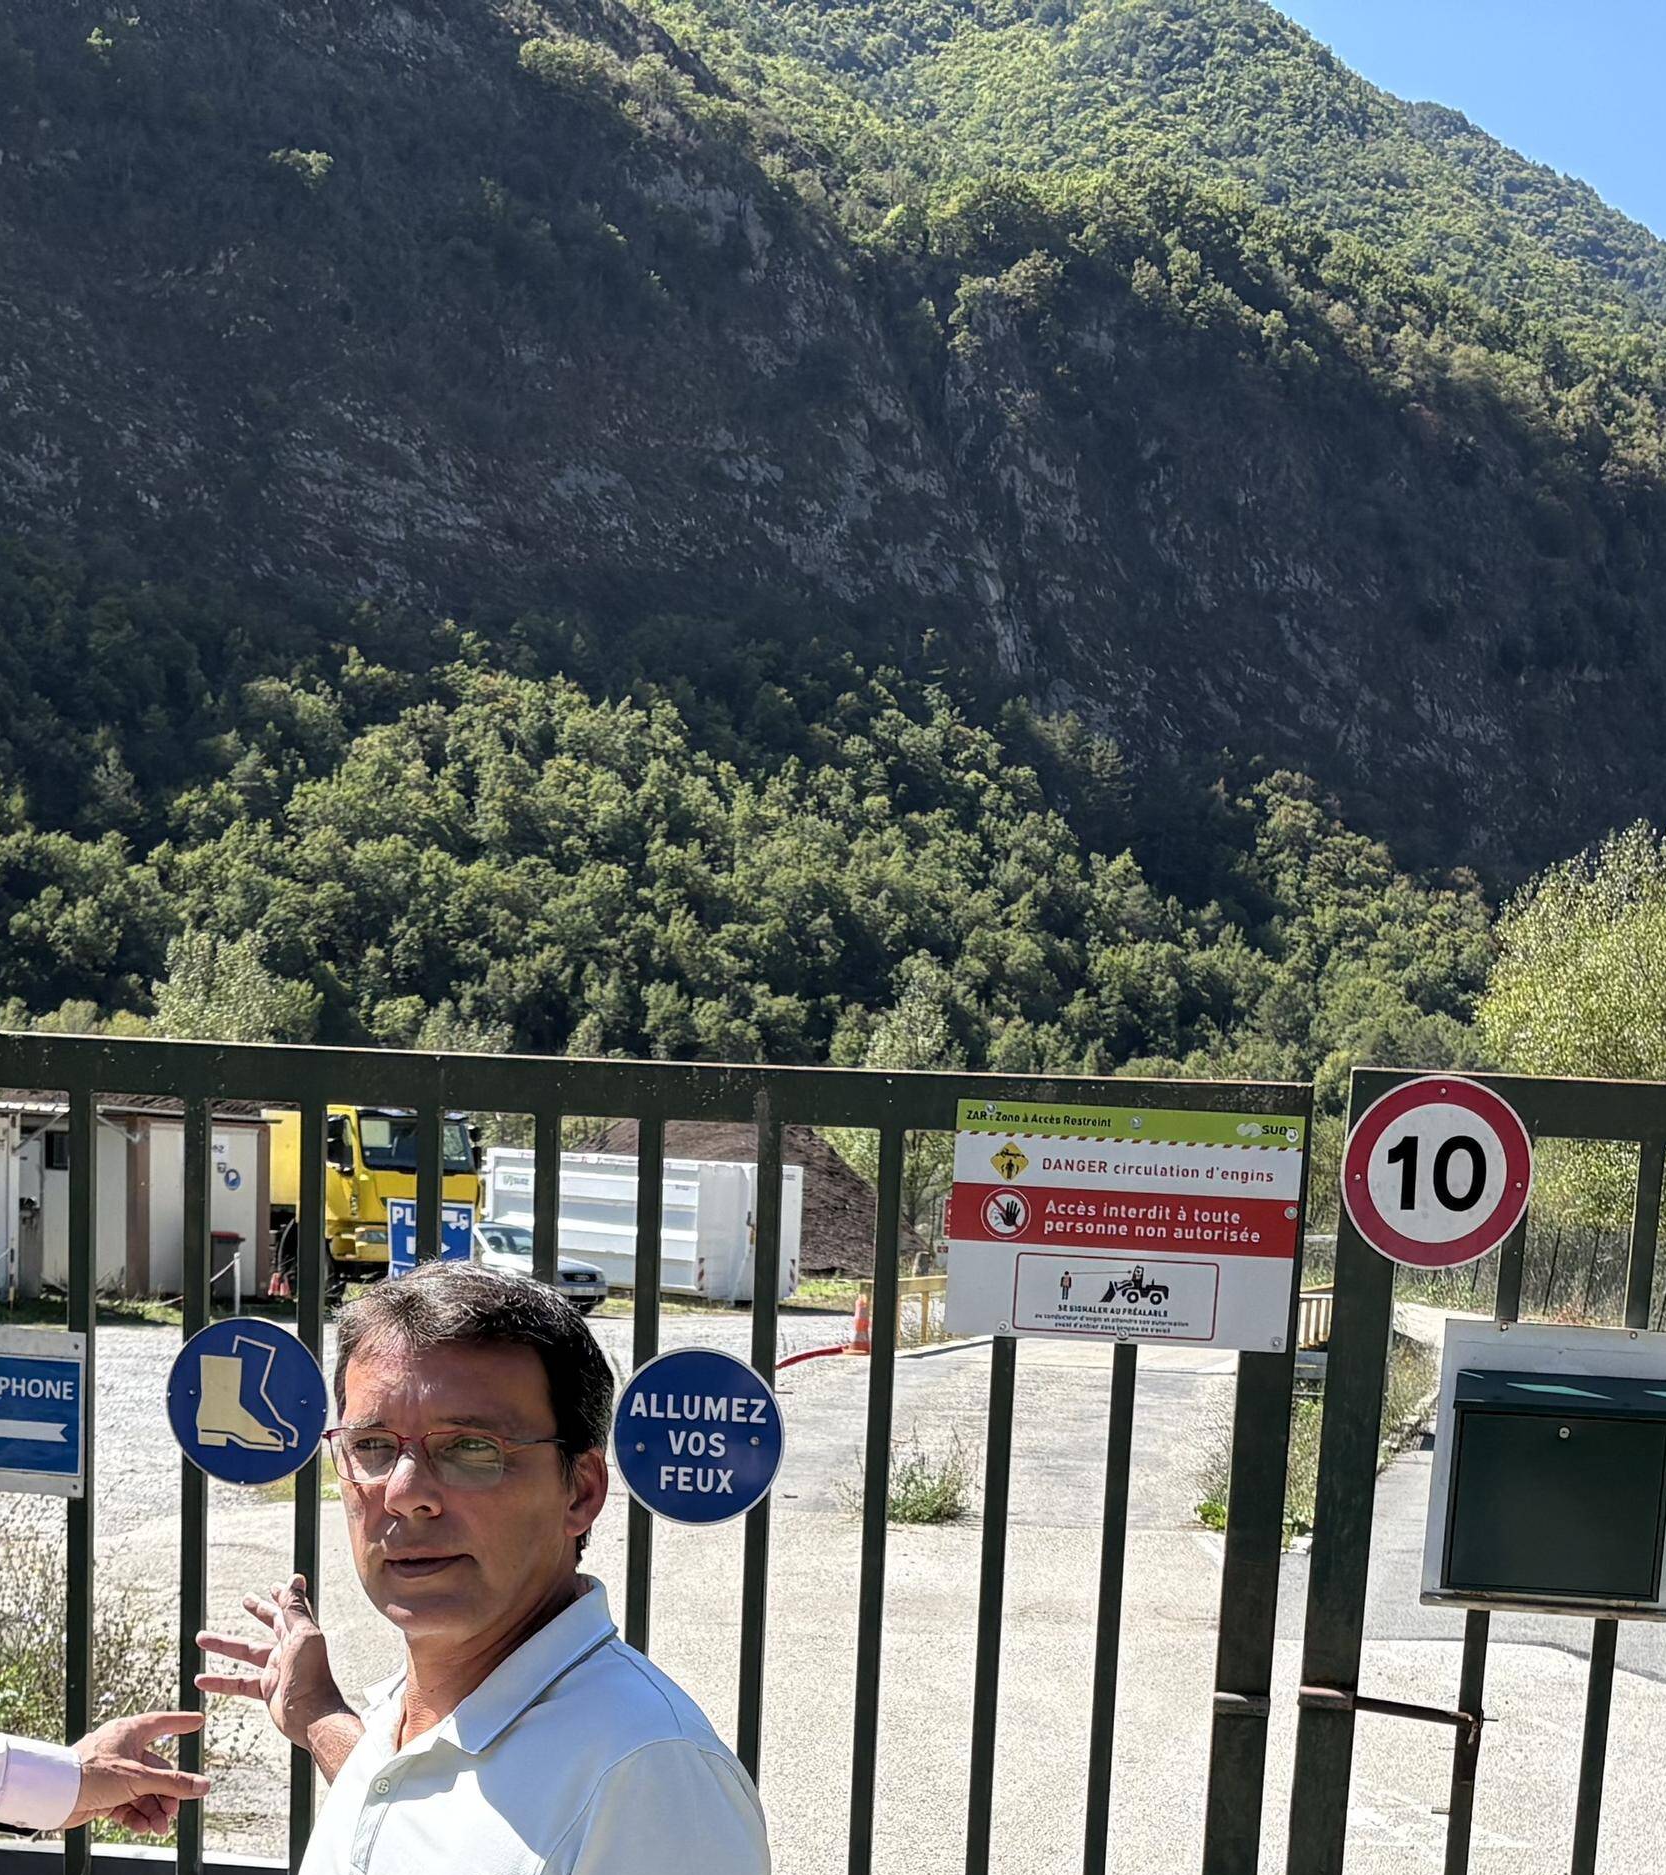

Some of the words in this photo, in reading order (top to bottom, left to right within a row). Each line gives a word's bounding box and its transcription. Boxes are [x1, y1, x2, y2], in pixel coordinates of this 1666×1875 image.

[966, 1110, 987, 1121] ZAR
[995, 1111, 1020, 1122] Zone
[1022, 1112, 1028, 1123] à
[1031, 1113, 1061, 1125] Accès
[1063, 1115, 1111, 1128] Restreint
[1261, 1124, 1298, 1138] sue
[1042, 1158, 1108, 1174] DANGER
[1113, 1161, 1199, 1179] circulation
[1205, 1166, 1274, 1184] d'engins
[1386, 1135, 1487, 1213] 10
[1045, 1200, 1096, 1217] Accès
[1103, 1202, 1171, 1221] interdit
[1177, 1206, 1187, 1222] à
[1194, 1208, 1241, 1224] toute
[1044, 1219, 1128, 1236] personne
[1134, 1223, 1167, 1238] non
[1173, 1226, 1261, 1243] autorisée
[1110, 1307, 1121, 1315] AU
[630, 1392, 767, 1424] ALLUMEZ
[668, 1430, 726, 1458] VOS
[660, 1466, 734, 1494] FEUX
